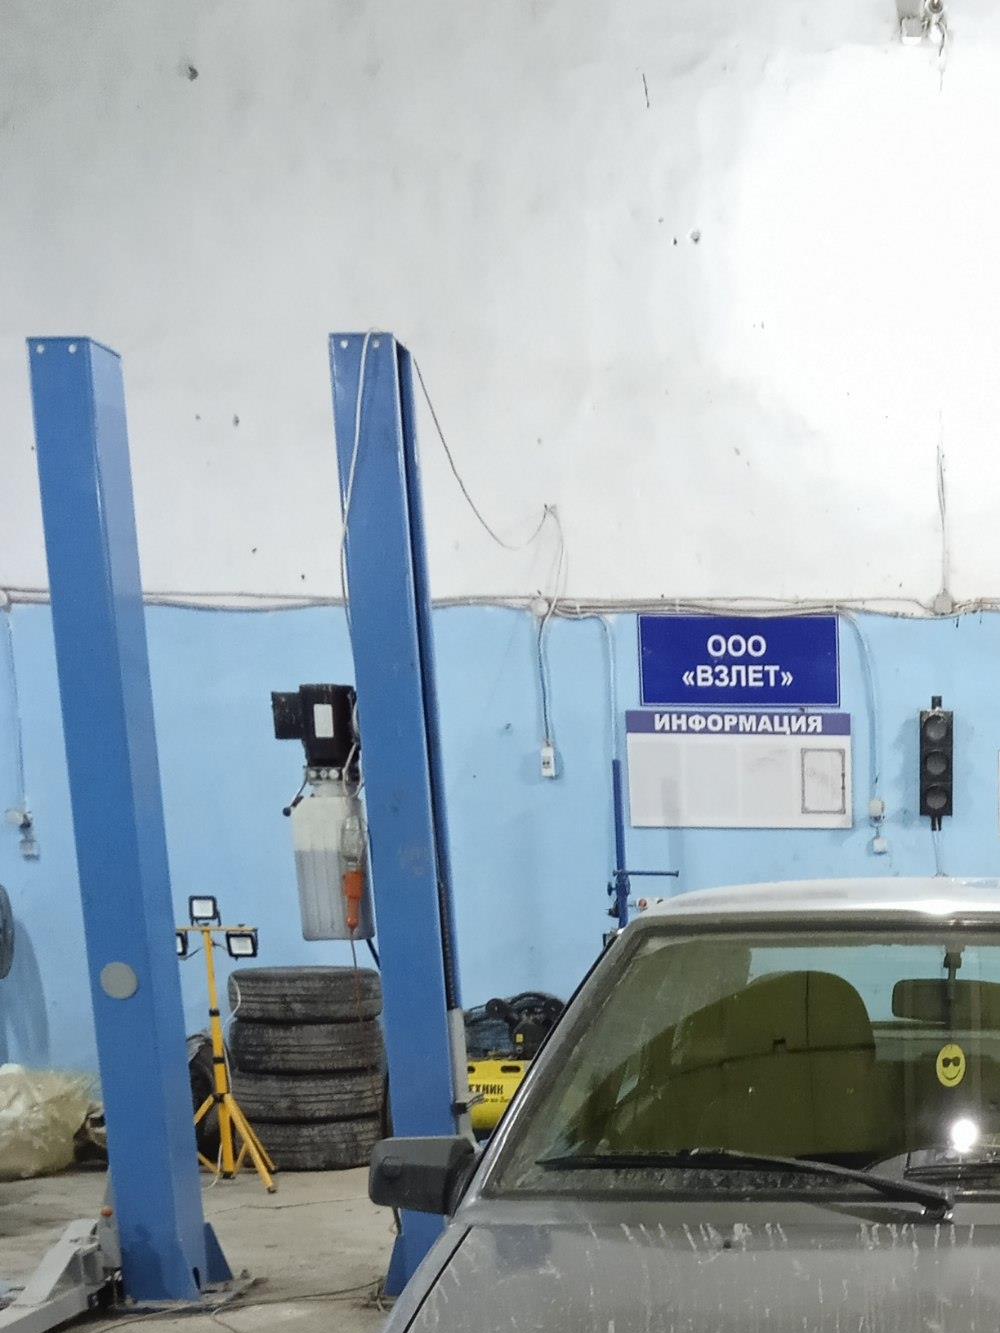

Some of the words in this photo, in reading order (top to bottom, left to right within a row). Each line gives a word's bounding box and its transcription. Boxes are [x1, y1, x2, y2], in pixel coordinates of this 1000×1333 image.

[706, 634, 767, 658] ООО
[681, 664, 794, 688] «ВЗЛЕТ»
[653, 713, 823, 736] ИНФОРМАЦИЯ
